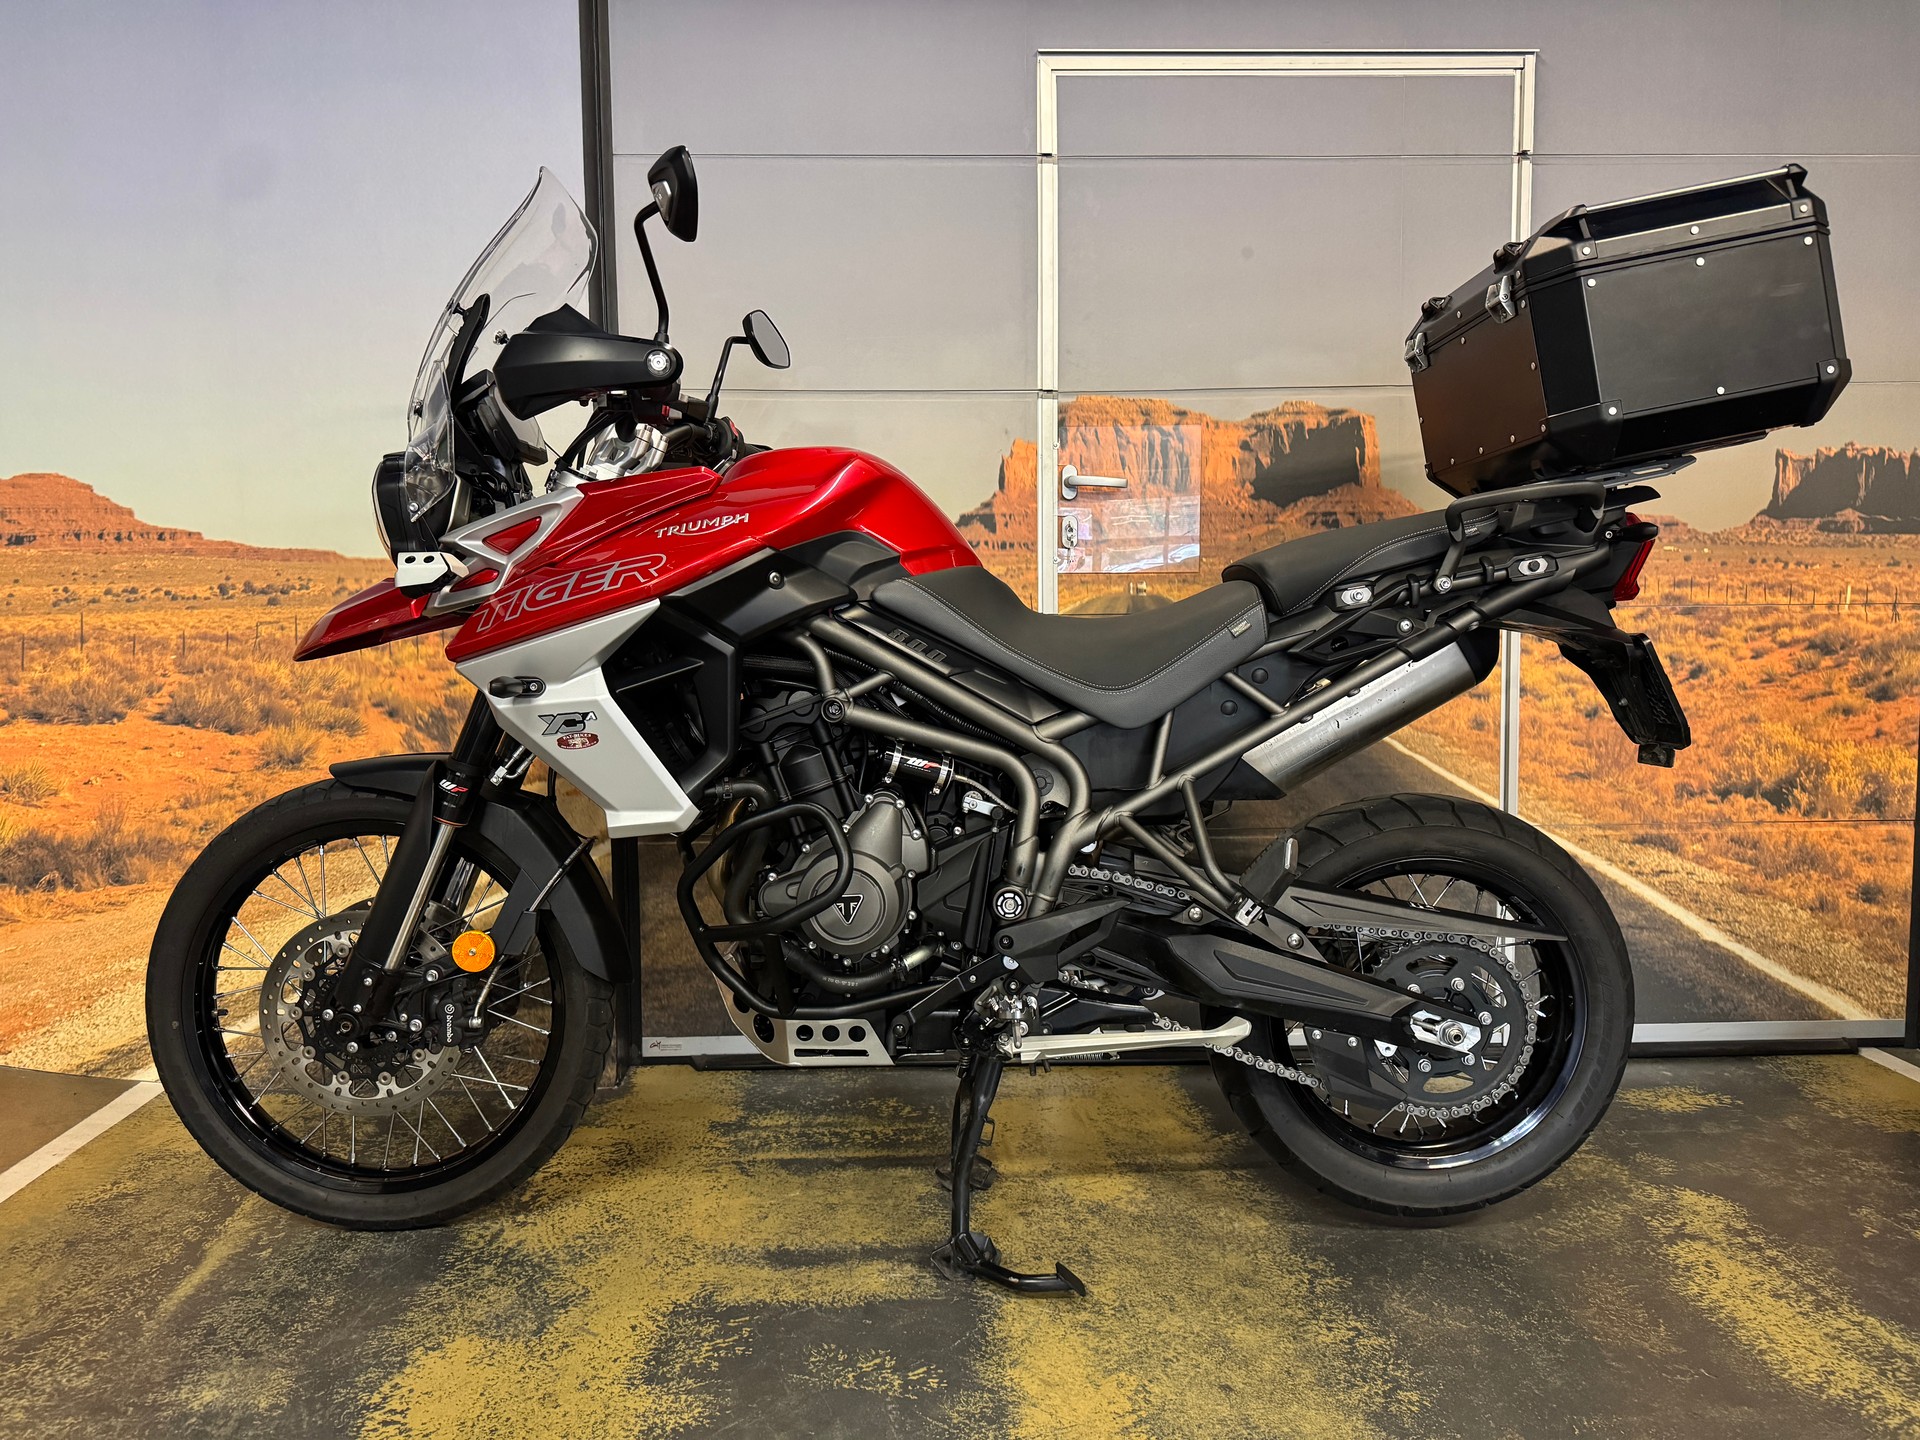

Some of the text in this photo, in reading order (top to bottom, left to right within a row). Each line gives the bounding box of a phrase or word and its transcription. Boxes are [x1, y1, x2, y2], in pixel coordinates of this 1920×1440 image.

[655, 513, 750, 538] TRIUMPH
[473, 553, 667, 633] TIGER
[887, 628, 948, 663] 800
[439, 779, 469, 792] WP
[446, 1014, 454, 1043] brembo
